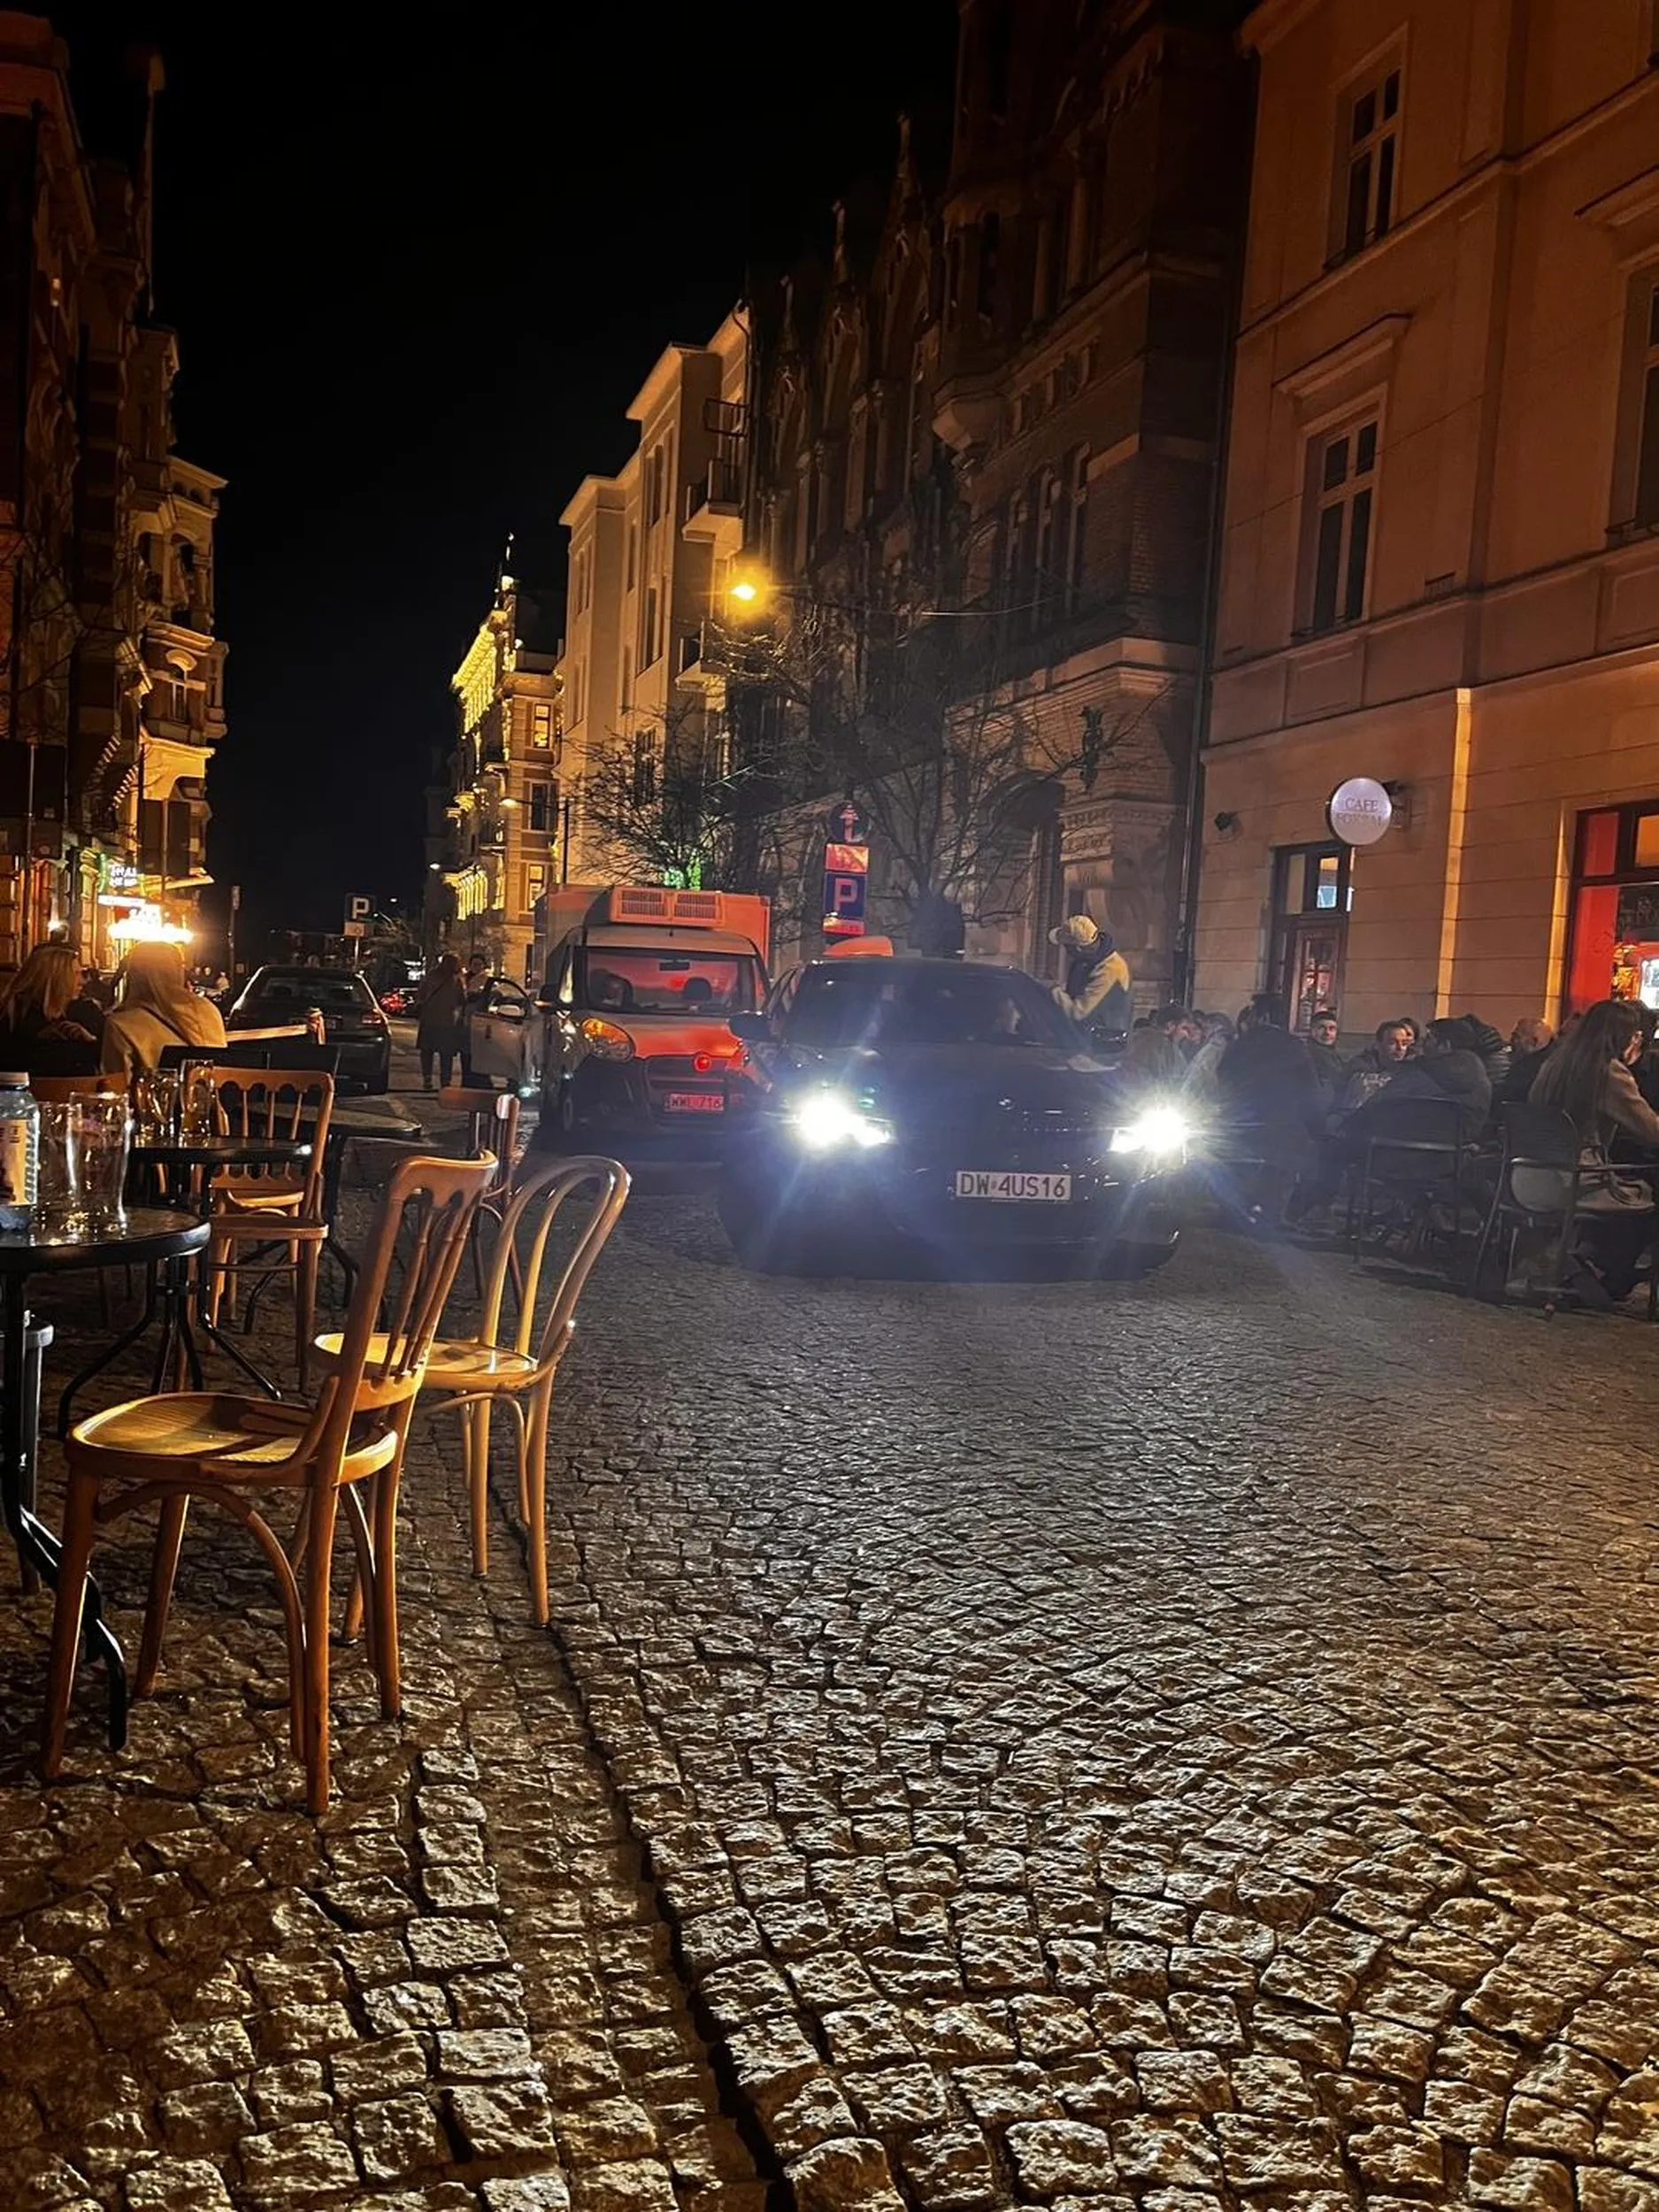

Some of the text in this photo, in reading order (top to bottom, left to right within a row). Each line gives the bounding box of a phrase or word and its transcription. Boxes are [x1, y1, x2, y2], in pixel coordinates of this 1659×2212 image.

[1344, 796, 1379, 812] CAFE
[833, 877, 858, 912] P
[351, 897, 370, 919] P
[960, 1173, 990, 1194] DW
